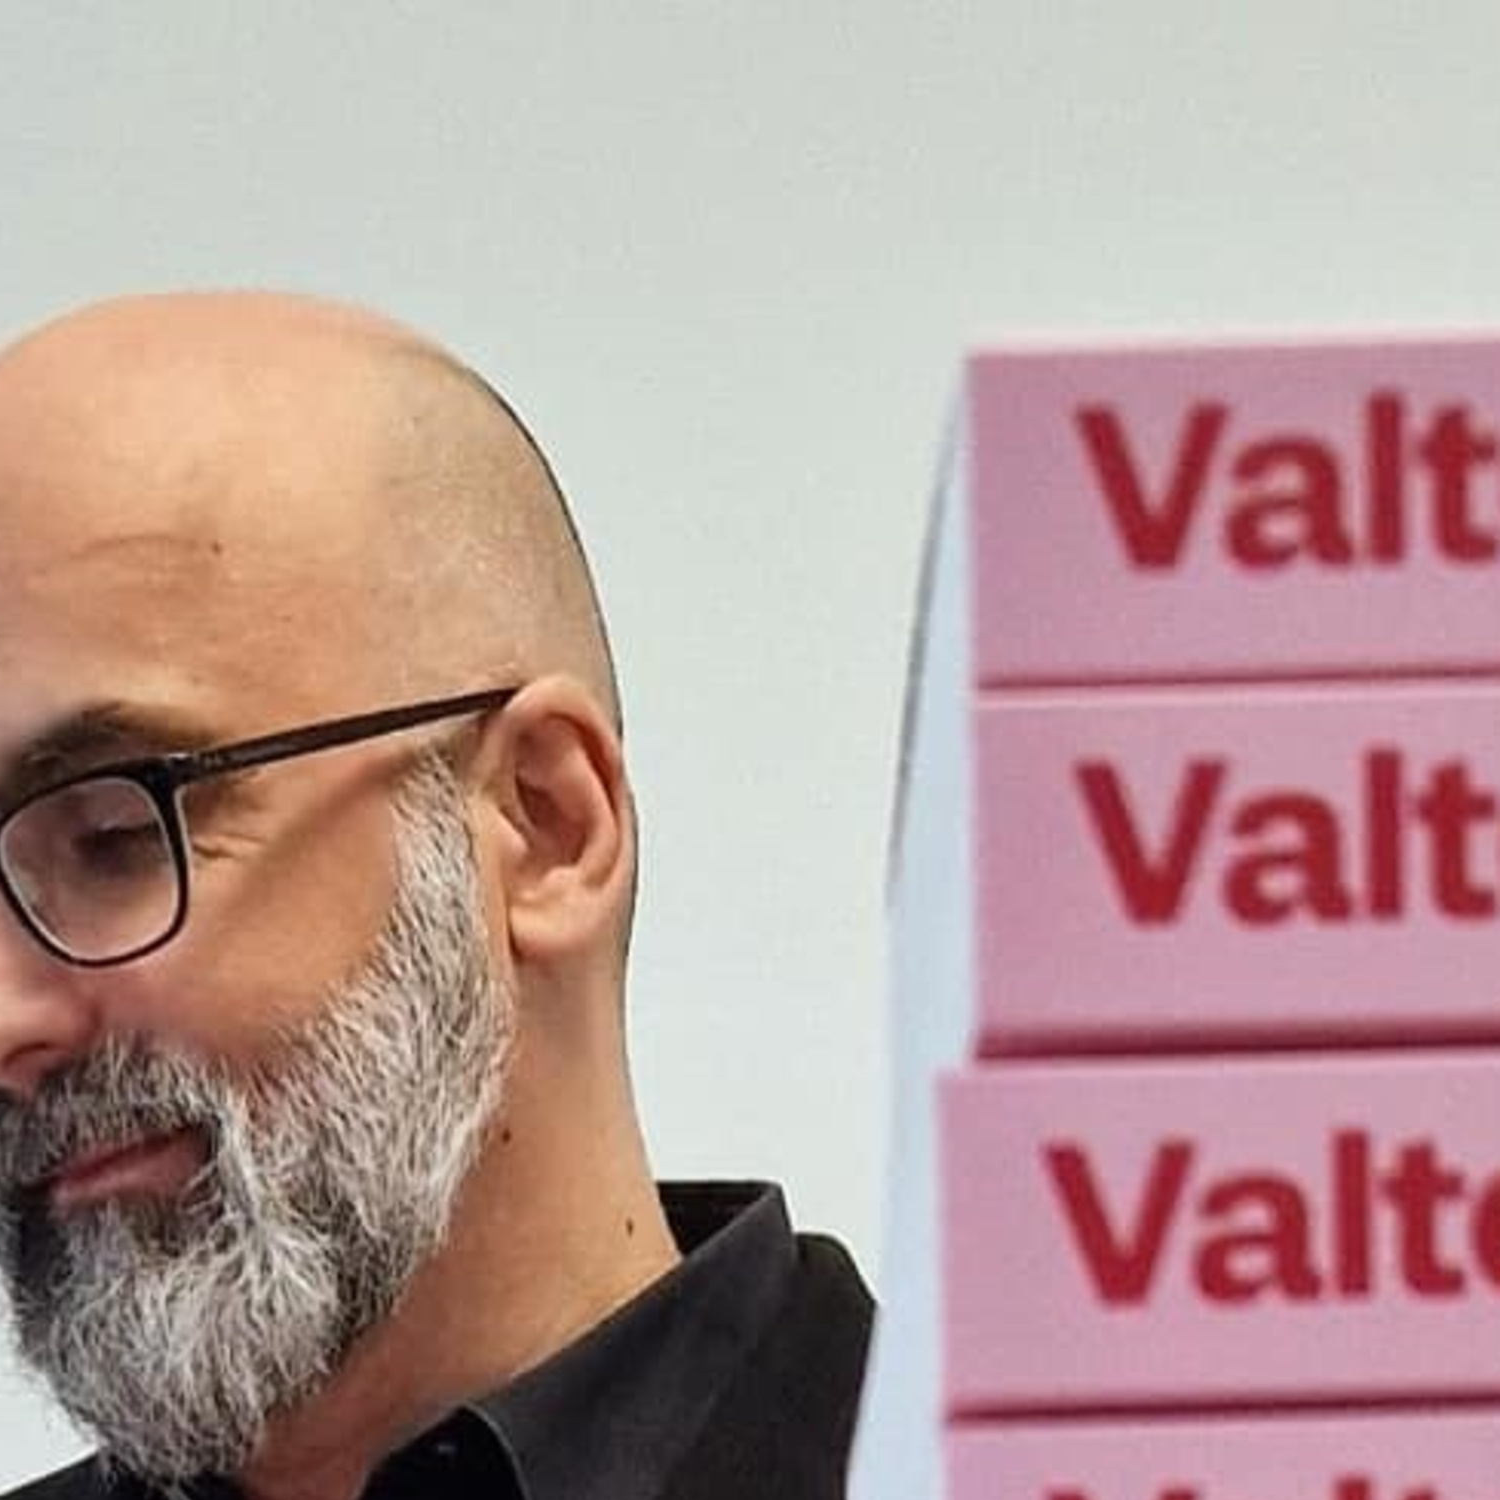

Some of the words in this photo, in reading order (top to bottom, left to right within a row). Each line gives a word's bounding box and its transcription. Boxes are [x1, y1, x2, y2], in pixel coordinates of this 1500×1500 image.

[1078, 393, 1498, 571] Valt
[1075, 749, 1498, 926] Valt
[1045, 1129, 1500, 1307] Valt
